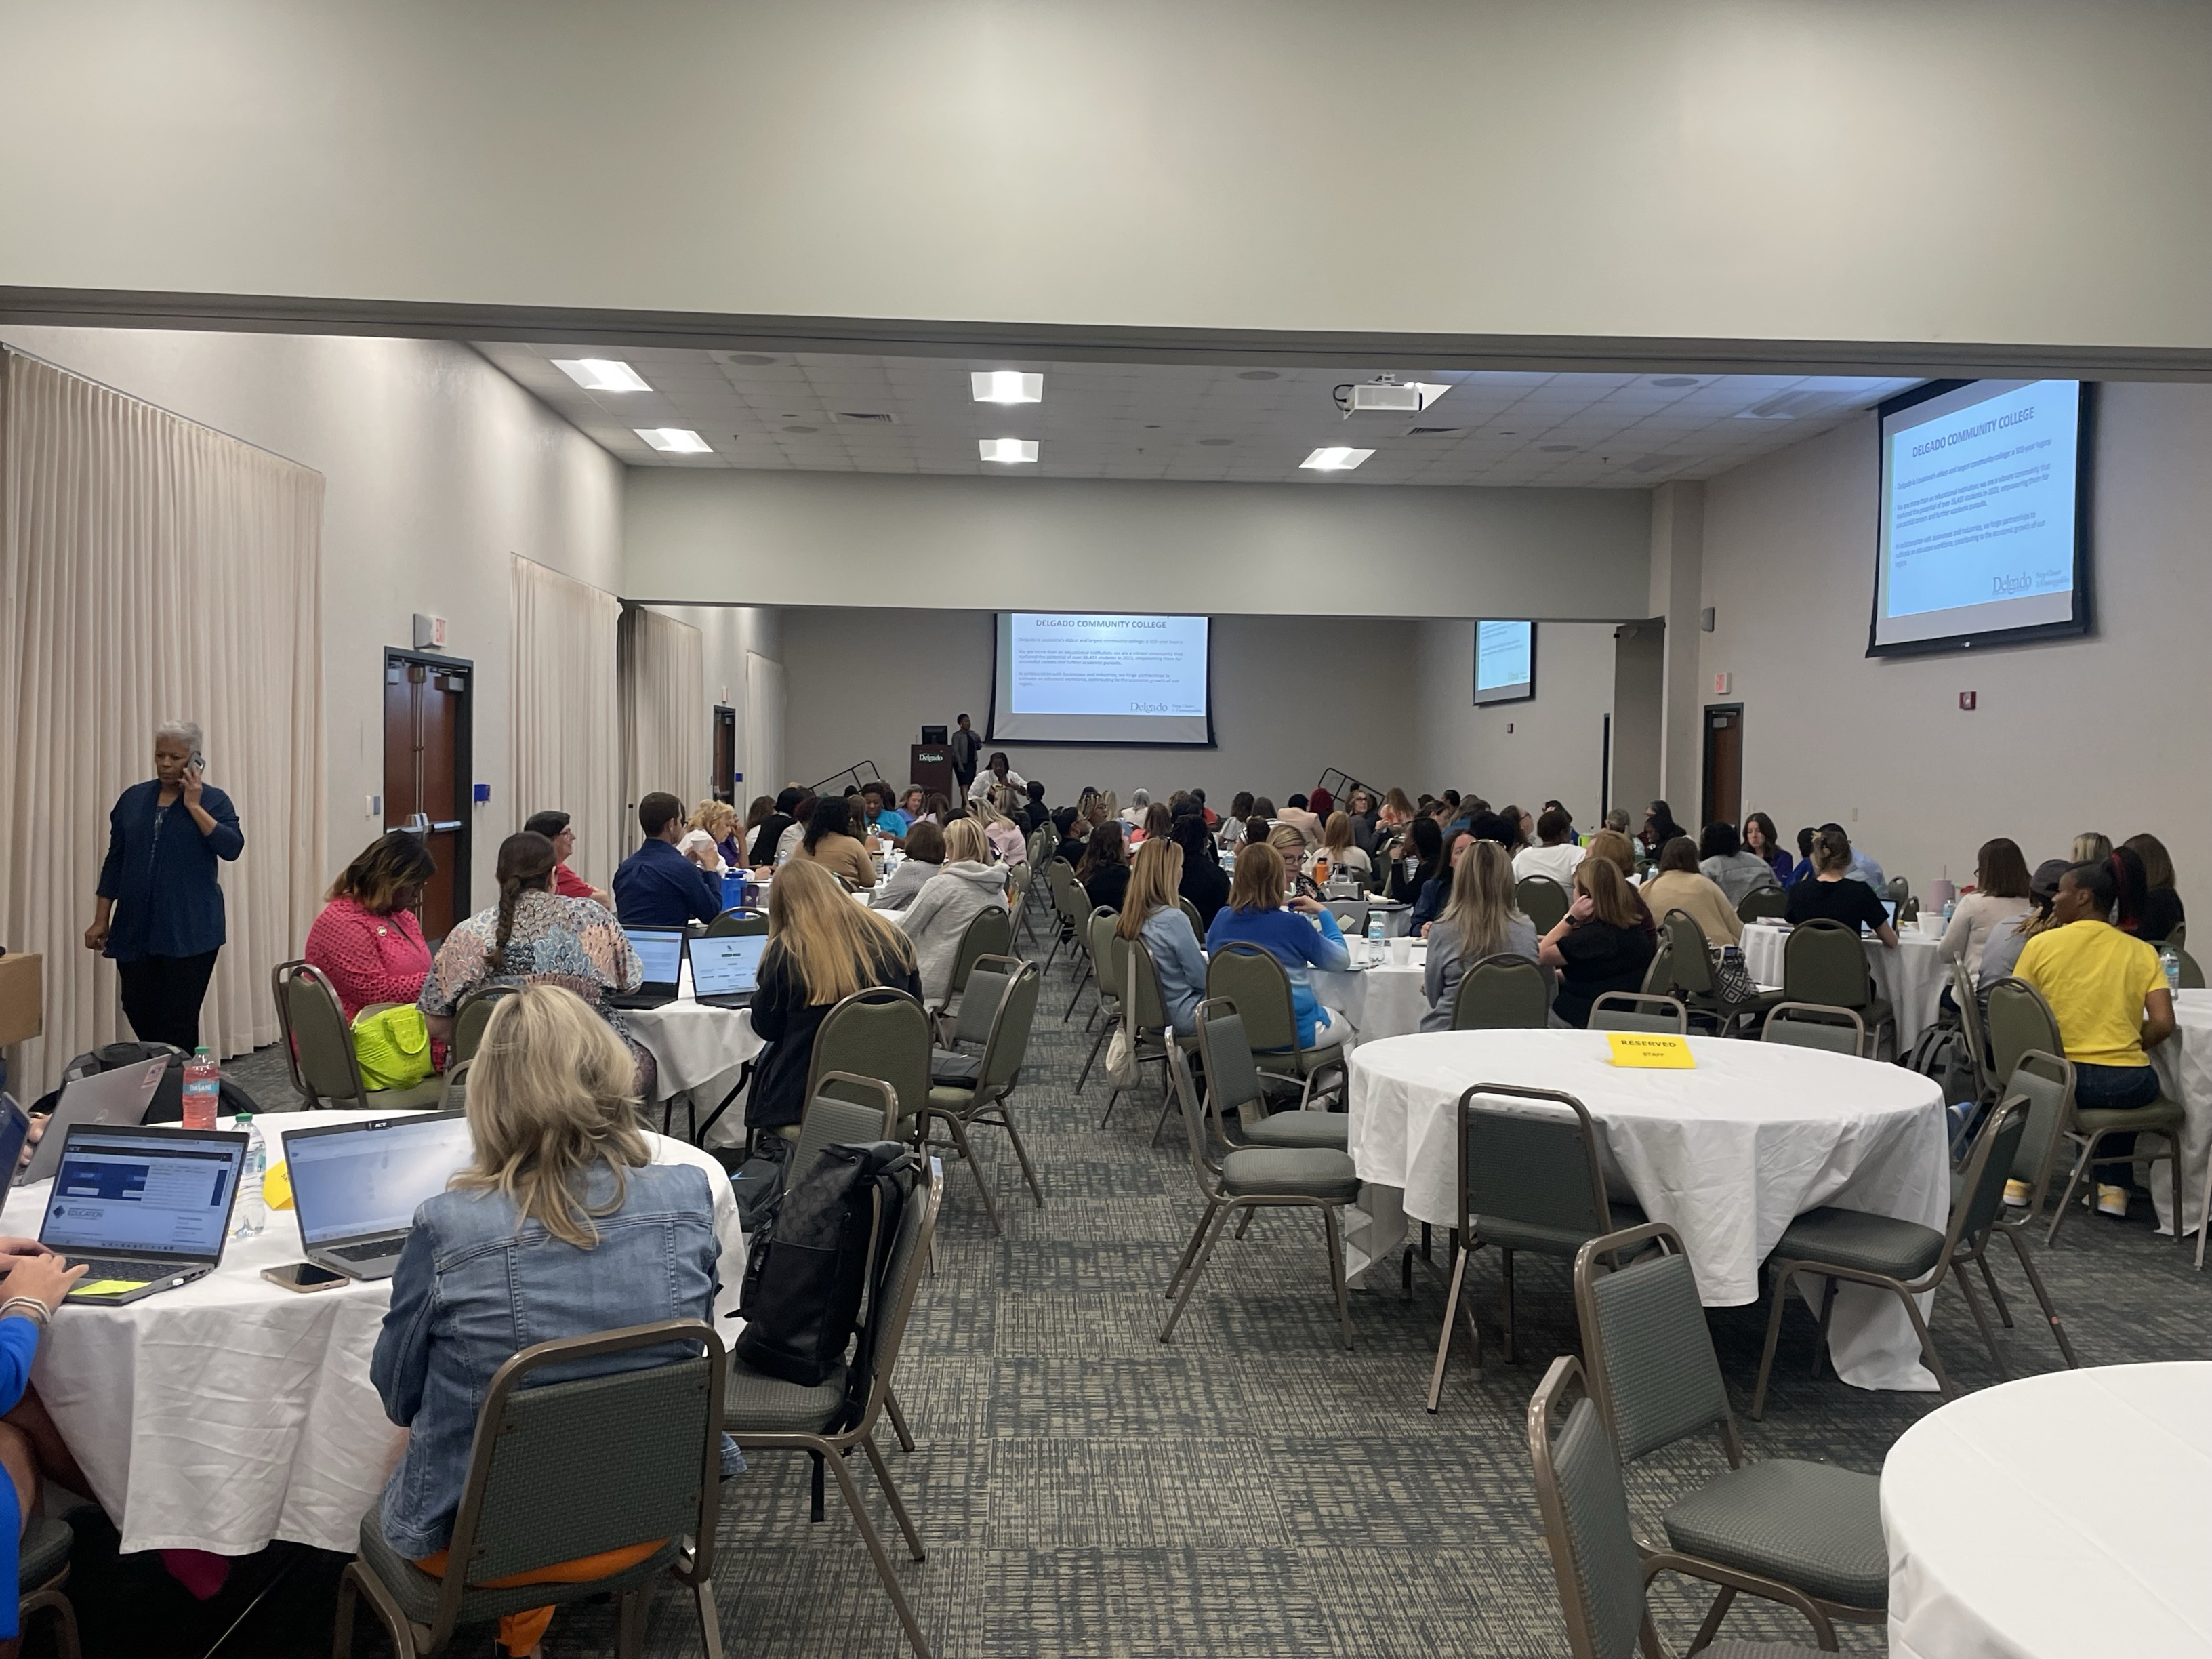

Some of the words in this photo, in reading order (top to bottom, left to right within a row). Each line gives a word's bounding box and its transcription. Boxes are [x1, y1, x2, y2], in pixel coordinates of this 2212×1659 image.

[1912, 437, 1946, 458] DELGADO
[1947, 419, 1997, 446] COMMUNITY
[1999, 406, 2035, 429] COLLEGE
[1992, 572, 2032, 594] Delgado
[1077, 620, 1130, 628] COMMUNITY
[1131, 621, 1167, 629] COLLEGE
[1130, 702, 1168, 713] Delgado
[918, 754, 943, 762] Delgado
[190, 1084, 211, 1092] DASANI
[68, 1209, 104, 1218] EDUCATION
